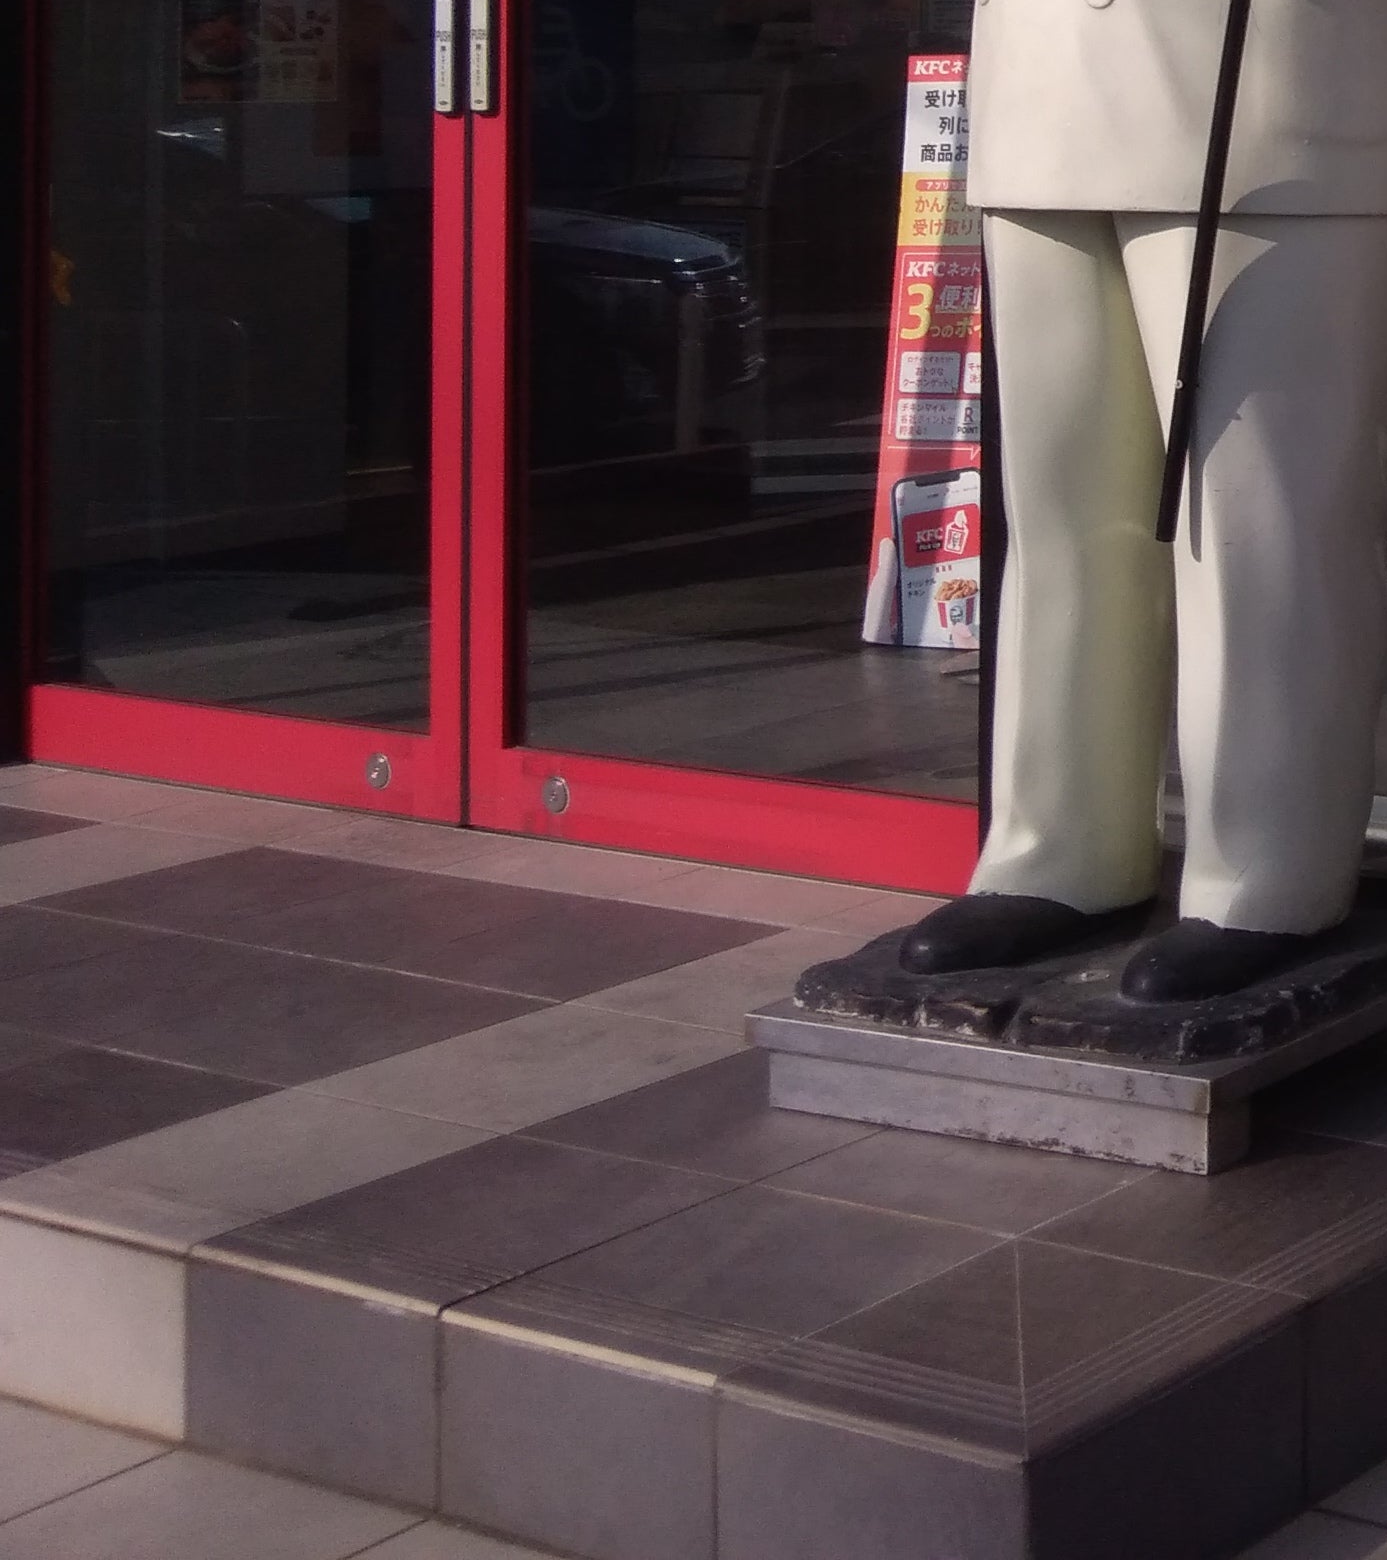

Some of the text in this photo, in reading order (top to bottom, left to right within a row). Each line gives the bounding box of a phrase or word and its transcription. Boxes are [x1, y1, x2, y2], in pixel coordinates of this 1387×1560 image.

[940, 285, 981, 311] 便利
[957, 426, 978, 434] POINT
[916, 527, 944, 543] KFC
